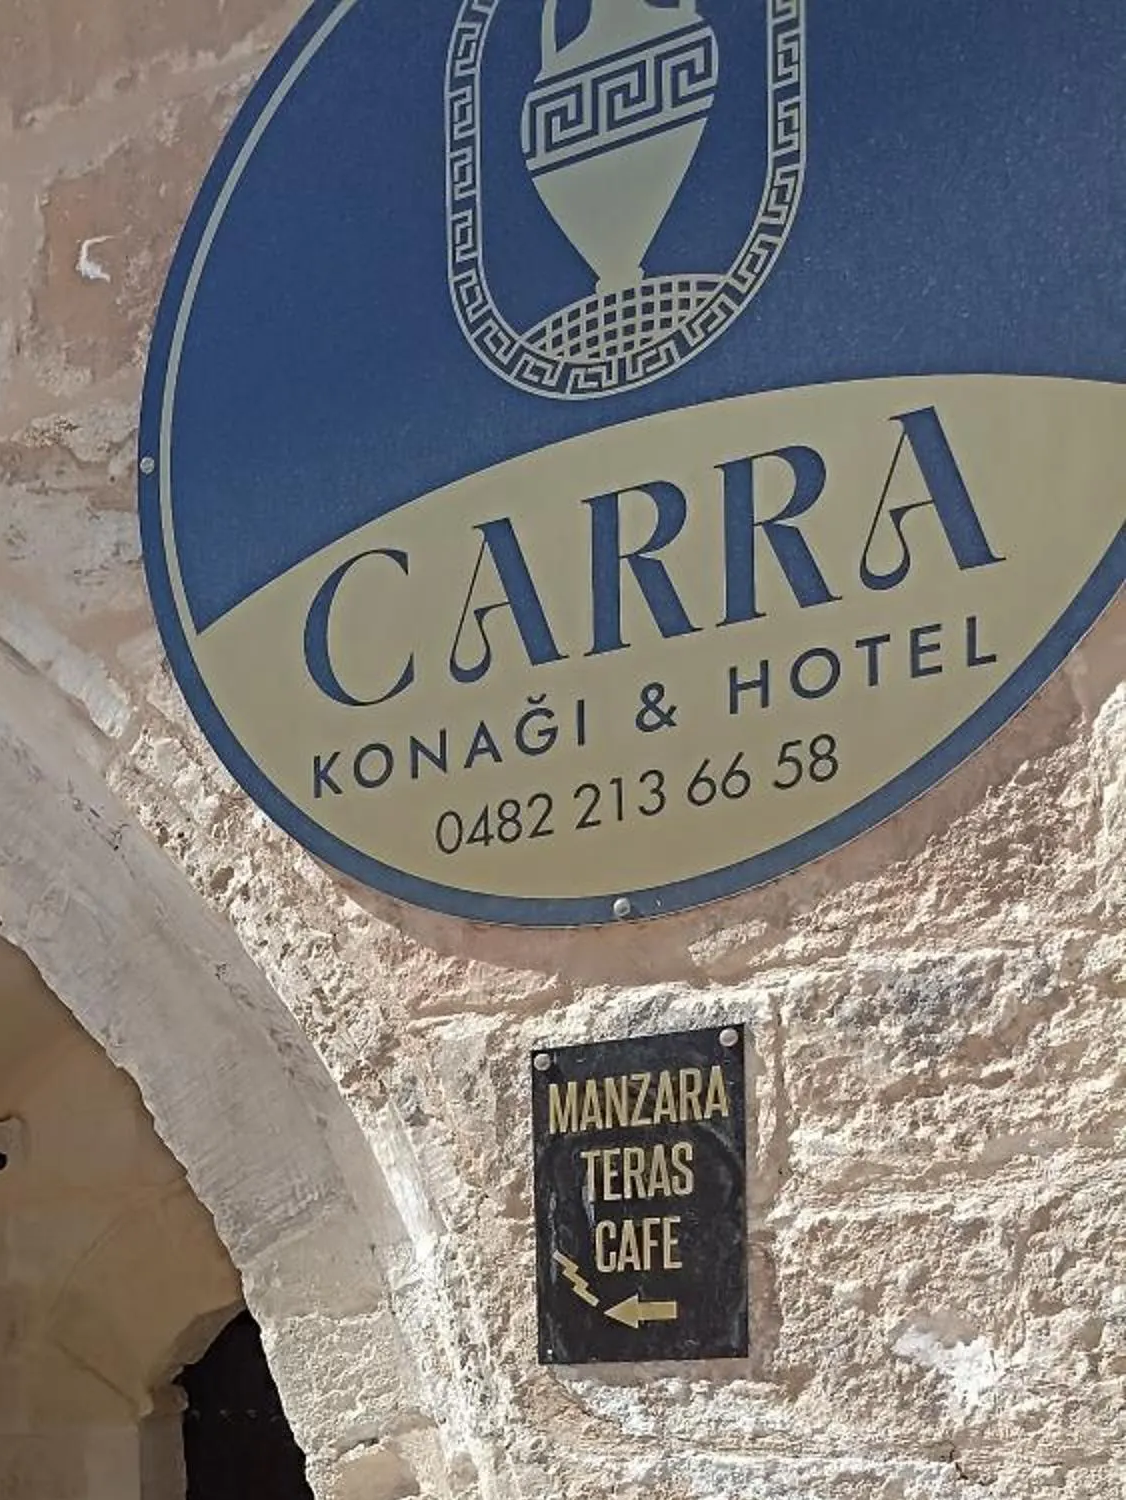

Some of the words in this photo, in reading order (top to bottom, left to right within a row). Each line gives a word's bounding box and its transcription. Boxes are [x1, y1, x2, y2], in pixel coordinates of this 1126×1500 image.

[303, 405, 1007, 707] CARRA
[313, 694, 586, 798] KONAĞI
[635, 682, 679, 733] &
[729, 616, 998, 715] HOTEL
[436, 792, 555, 855] 0482
[573, 768, 667, 831] 213
[686, 749, 752, 808] 66
[773, 733, 840, 792] 58
[548, 1065, 729, 1135] MANZARA
[580, 1141, 695, 1201] TERAS
[594, 1216, 683, 1273] CAFE
